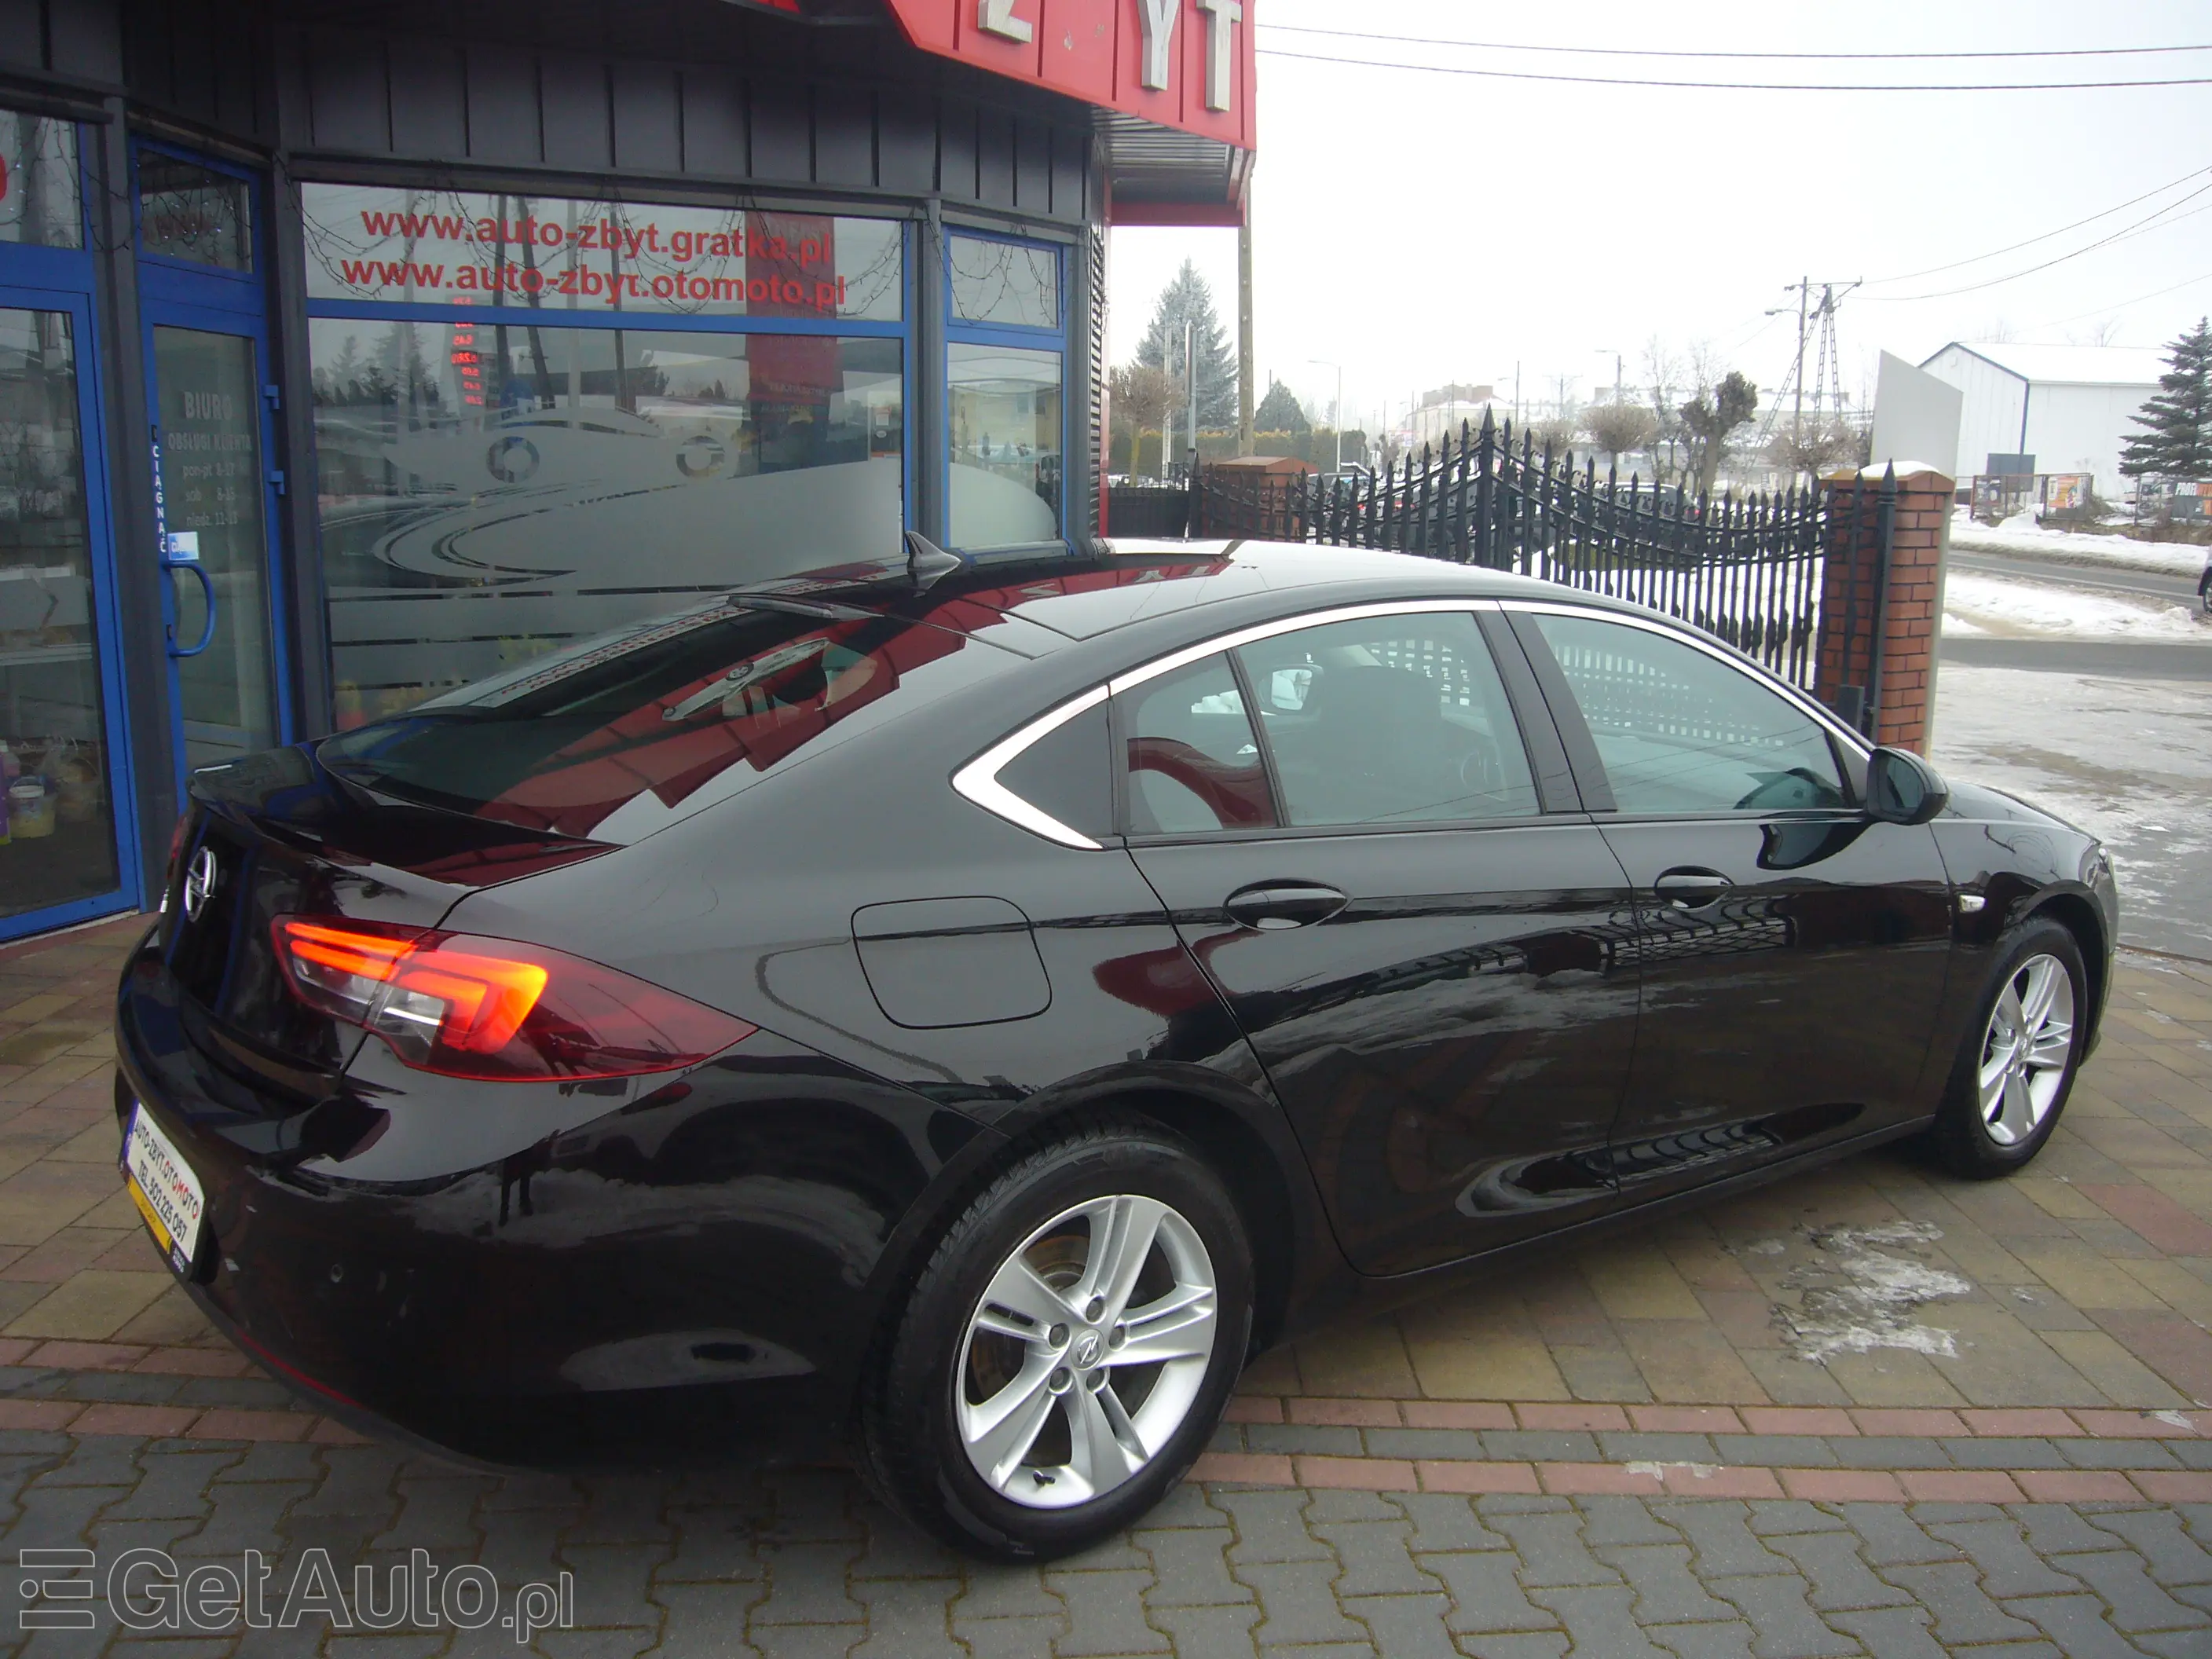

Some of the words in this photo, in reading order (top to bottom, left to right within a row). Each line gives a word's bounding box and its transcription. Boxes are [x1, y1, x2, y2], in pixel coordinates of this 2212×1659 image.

[361, 211, 830, 269] www.auto-zbyt.gratka.pl
[340, 259, 845, 313] www.auto-zbyt.otomoto.pl
[184, 391, 233, 421] BIURO
